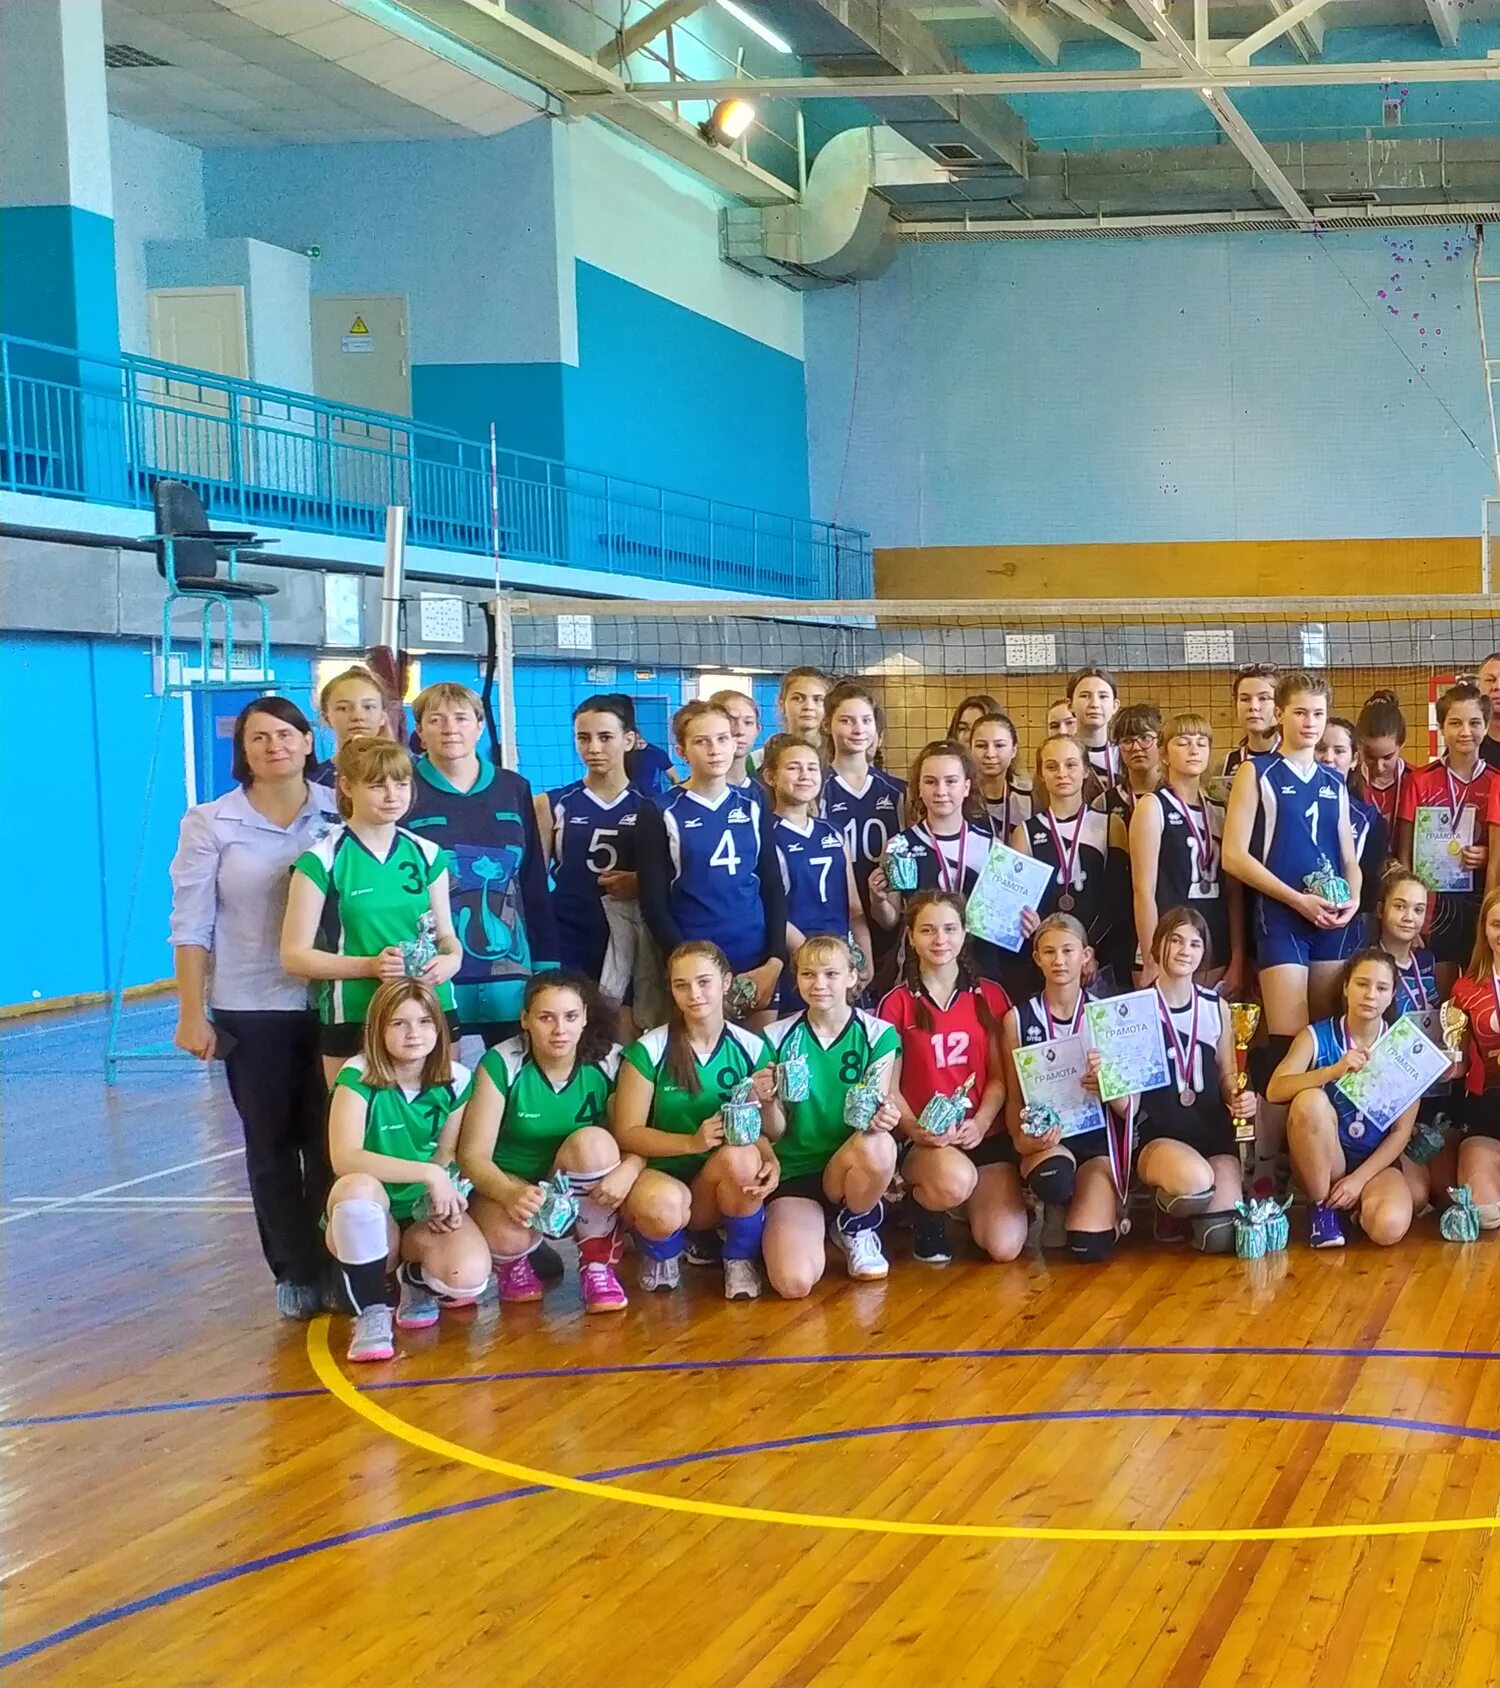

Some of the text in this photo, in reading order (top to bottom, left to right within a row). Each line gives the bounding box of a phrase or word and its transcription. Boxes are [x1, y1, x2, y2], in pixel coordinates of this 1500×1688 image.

[843, 818, 888, 863] 10
[1305, 801, 1320, 846] 1
[1425, 832, 1462, 841] ГРАМОТА
[586, 828, 618, 873] 5
[710, 829, 741, 875] 4
[398, 861, 423, 894] 3
[809, 856, 832, 902] 7
[992, 874, 1030, 896] ГРАМОТА
[1105, 1024, 1148, 1039] ГРАМОТА
[931, 1031, 969, 1068] 12
[1387, 1047, 1420, 1080] ГРАМОТА
[839, 1050, 862, 1084] 8
[1034, 1066, 1077, 1084] ГРАМОТА
[574, 1091, 602, 1125] 4
